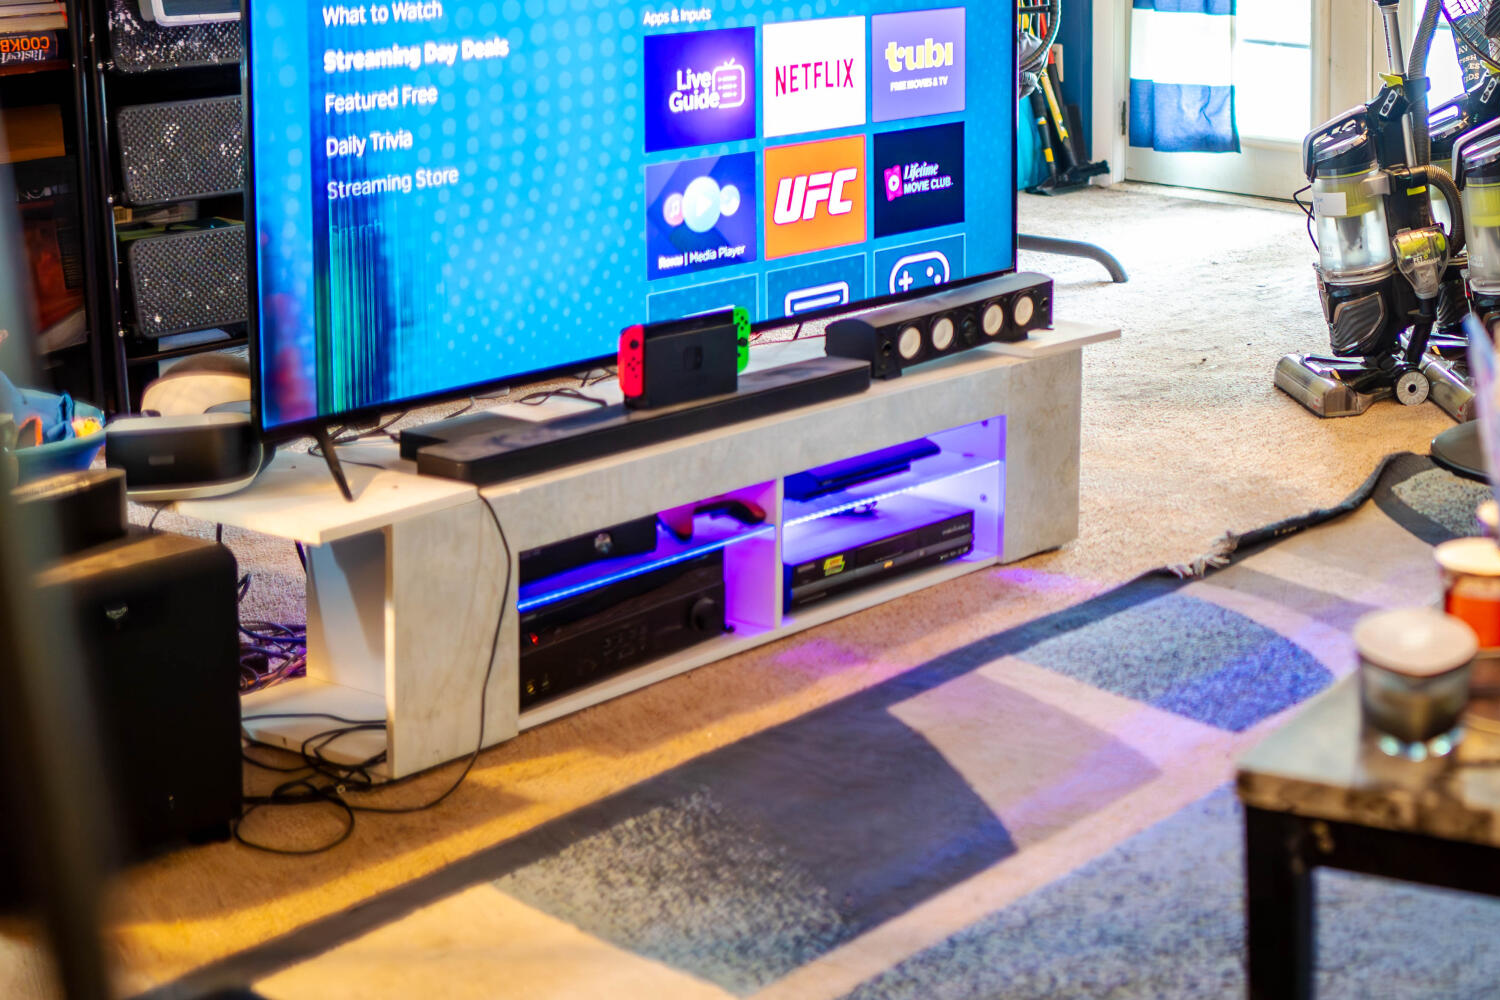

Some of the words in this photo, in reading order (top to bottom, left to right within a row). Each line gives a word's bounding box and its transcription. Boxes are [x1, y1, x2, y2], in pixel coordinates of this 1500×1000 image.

[322, 5, 366, 27] What
[370, 5, 389, 23] to
[391, 0, 443, 22] Watch
[643, 10, 669, 26] Apps
[670, 9, 679, 22] &
[680, 8, 712, 24] Inputs
[323, 40, 421, 73] Streaming
[424, 39, 457, 66] Day
[461, 35, 509, 60] Deals
[885, 37, 954, 73] tubi
[676, 69, 712, 92] Live
[775, 57, 854, 98] NETFLIX
[938, 75, 949, 86] TV
[324, 87, 398, 115] Featured
[400, 83, 438, 105] Free
[668, 88, 721, 113] Guide
[326, 133, 366, 157] Daily
[369, 128, 413, 151] Trivia
[326, 171, 412, 200] Streaming
[415, 166, 459, 189] Store
[903, 160, 940, 180] Lifetime
[773, 166, 858, 226] UFC
[903, 178, 930, 195] MOVIE
[688, 248, 717, 265] Media
[718, 243, 746, 261] Player
